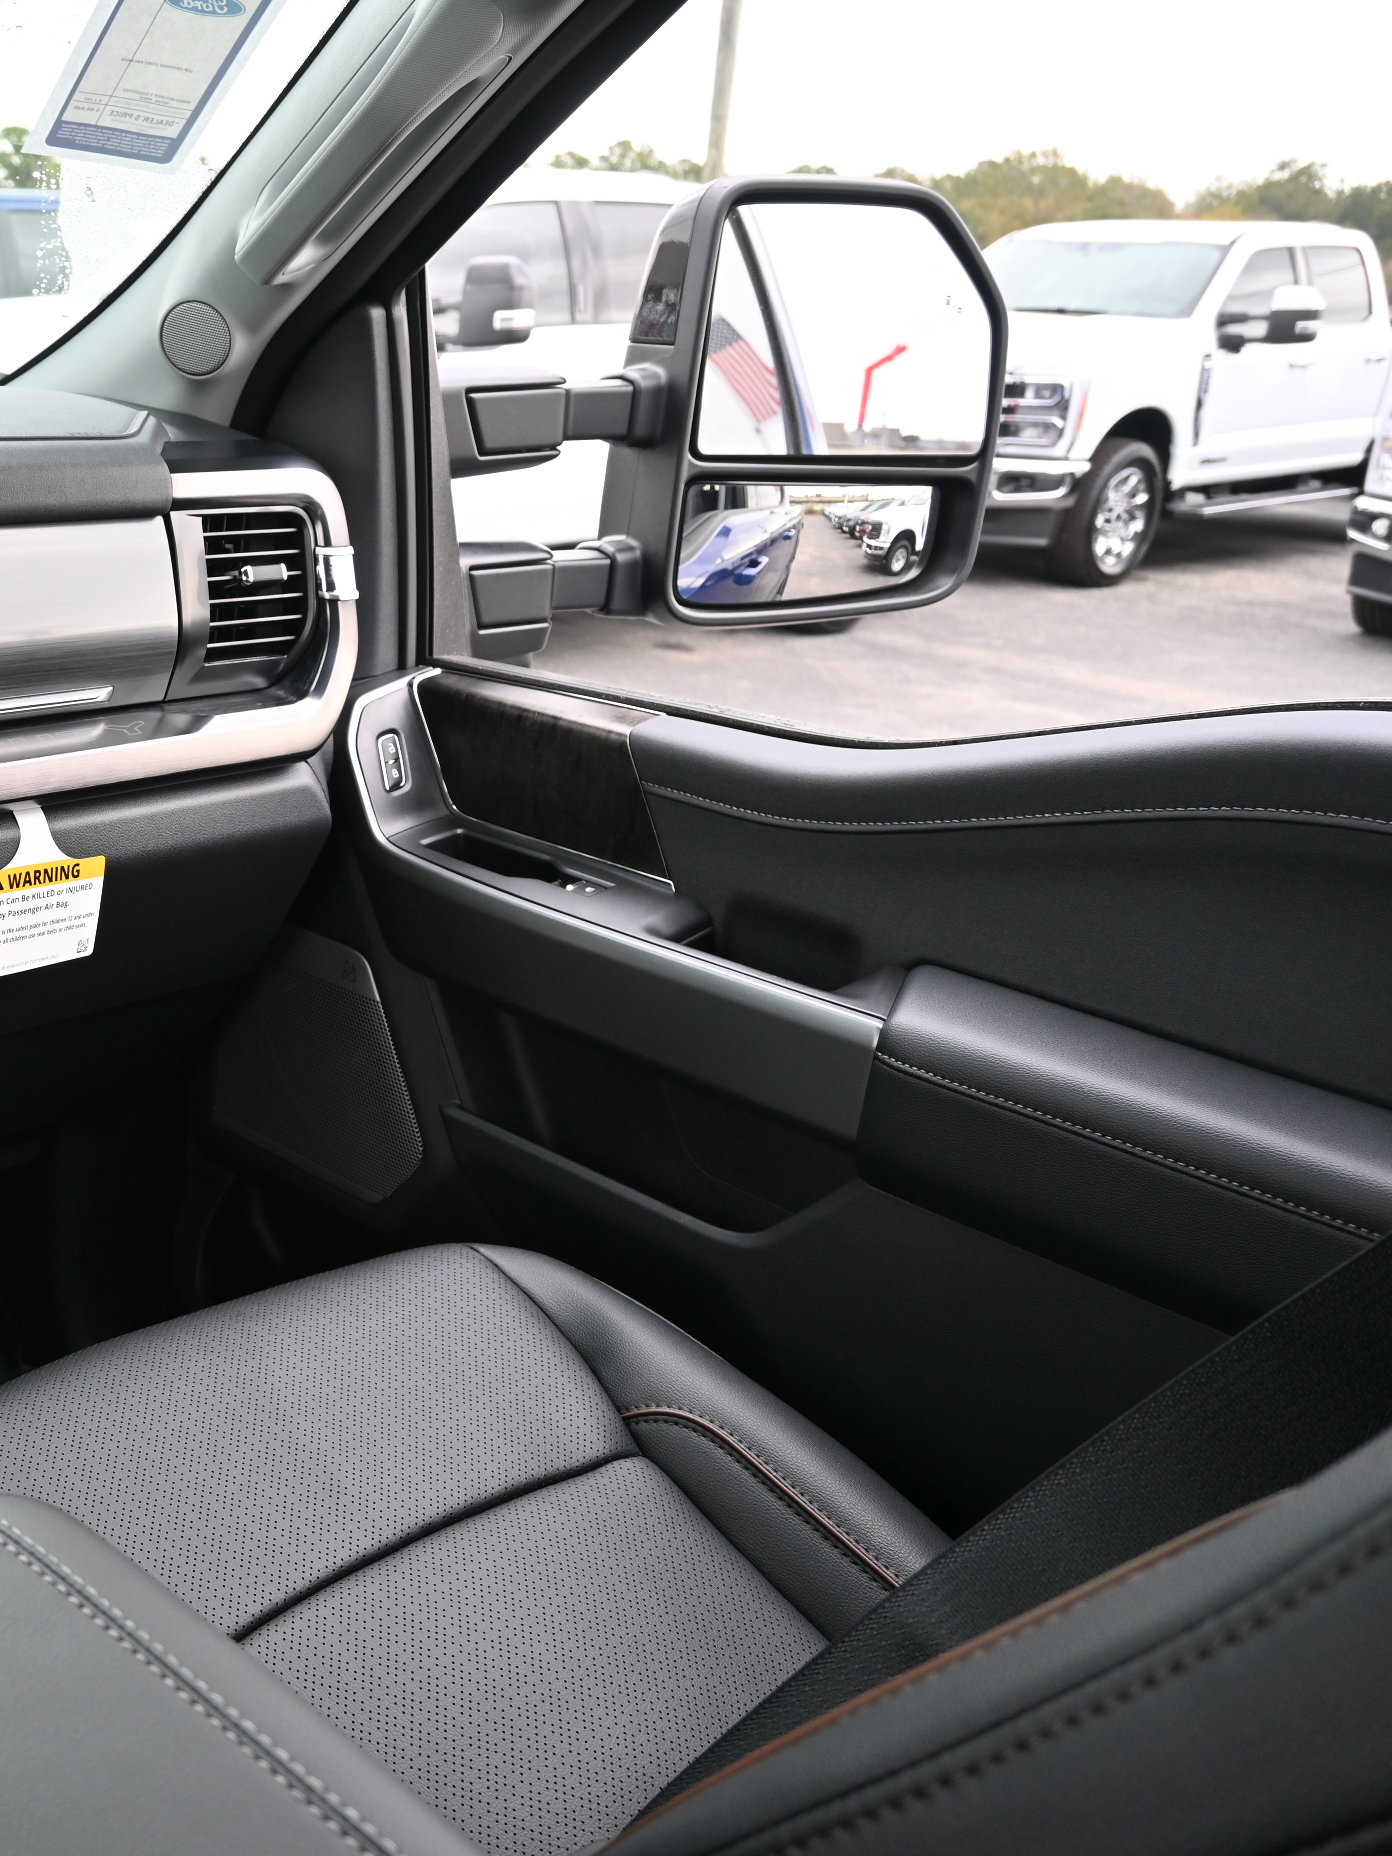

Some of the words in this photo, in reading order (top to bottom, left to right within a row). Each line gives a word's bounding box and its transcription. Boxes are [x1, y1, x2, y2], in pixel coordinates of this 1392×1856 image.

[8, 863, 80, 889] WARNING
[6, 896, 20, 905] Can
[31, 890, 55, 900] KILLED
[65, 883, 94, 895] INJURED
[8, 905, 43, 918] Passenger
[44, 902, 55, 910] Air
[56, 900, 69, 909] Bag.
[6, 927, 14, 935] the
[15, 924, 28, 933] safest
[29, 922, 41, 932] place
[50, 917, 66, 926] children
[82, 911, 95, 919] under
[9, 934, 27, 943] children
[37, 930, 46, 938] seat
[47, 928, 58, 936] belts
[64, 925, 74, 933] child
